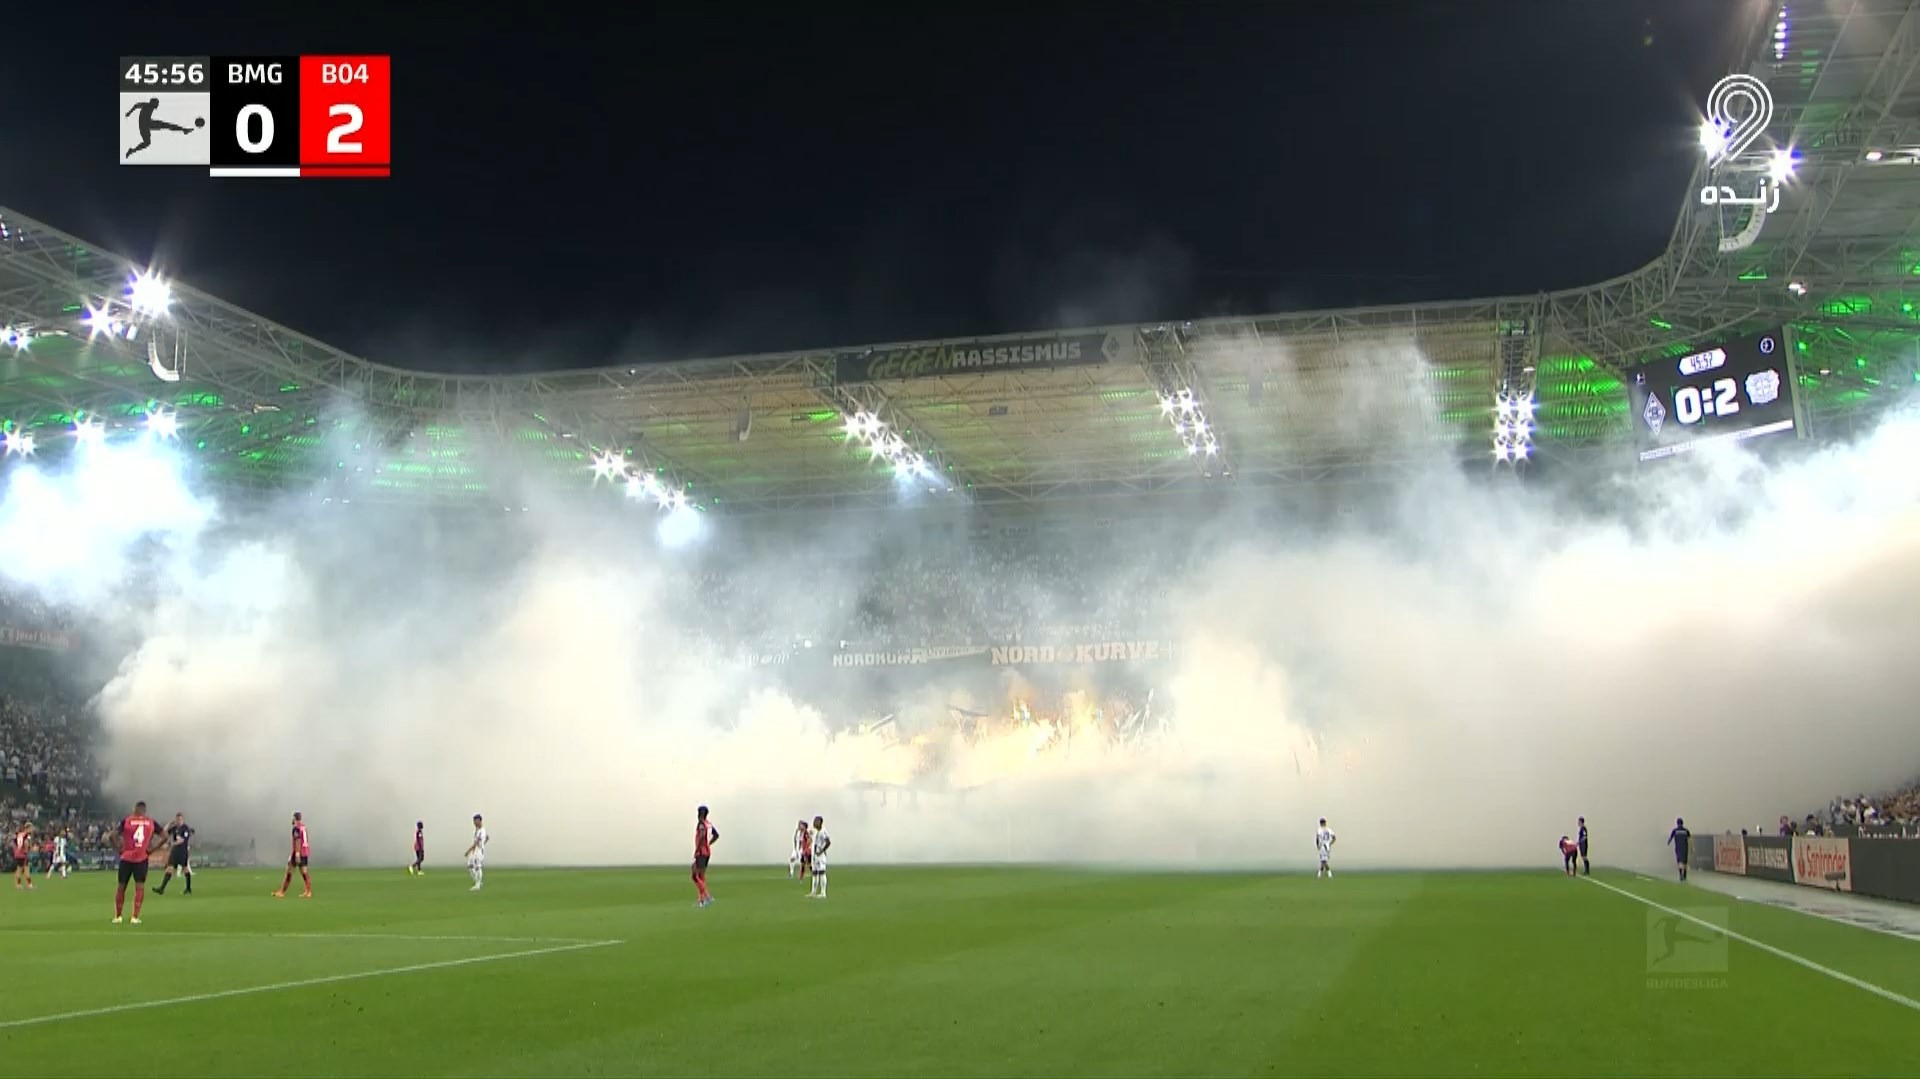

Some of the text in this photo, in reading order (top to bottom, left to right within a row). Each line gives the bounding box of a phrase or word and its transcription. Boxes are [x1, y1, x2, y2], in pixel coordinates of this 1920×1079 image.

[952, 341, 1081, 368] RASSISMUS
[1674, 378, 1740, 424] 0:2
[991, 646, 1055, 665] NORD
[1075, 639, 1159, 664] KURVE
[133, 825, 145, 846] 4
[1807, 844, 1846, 878] Santander
